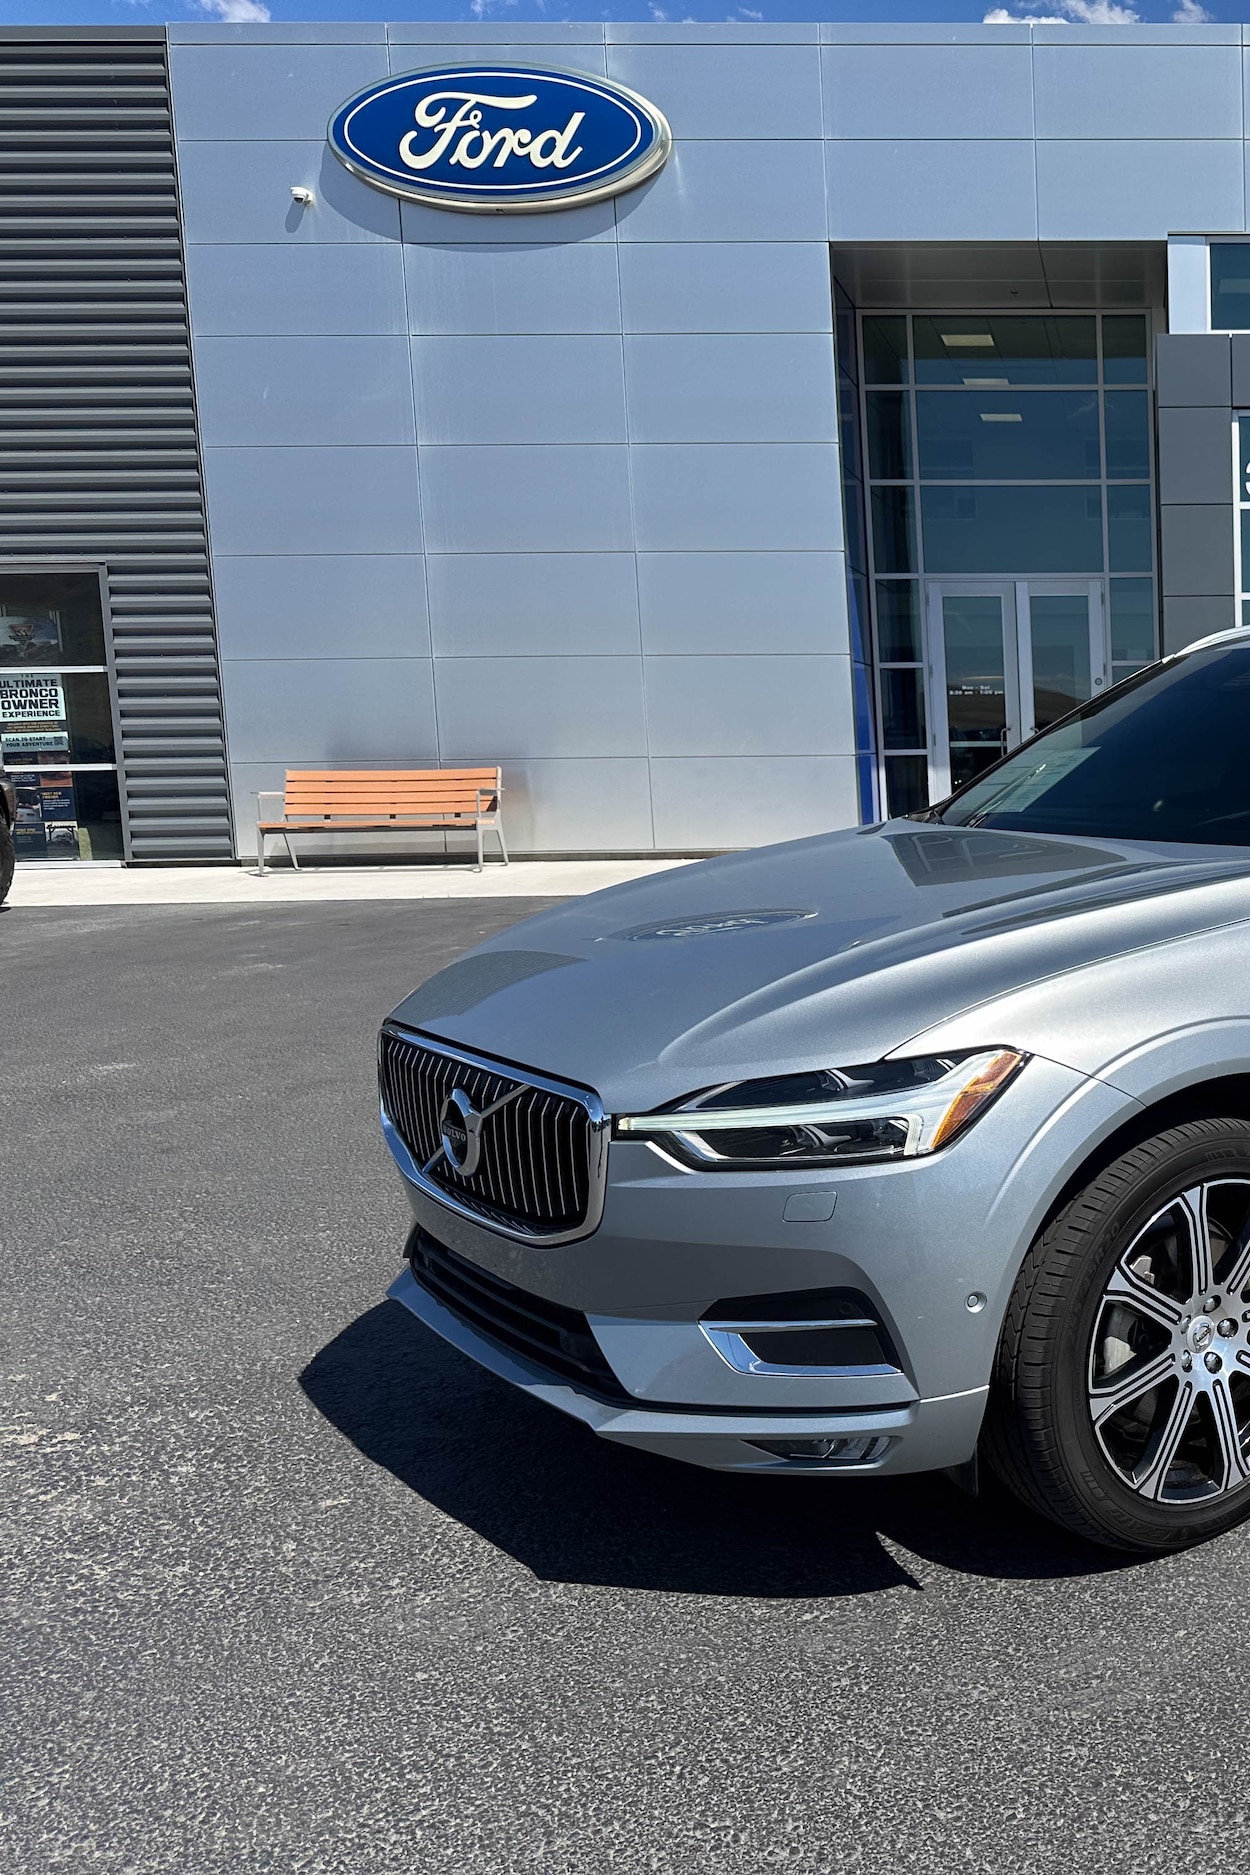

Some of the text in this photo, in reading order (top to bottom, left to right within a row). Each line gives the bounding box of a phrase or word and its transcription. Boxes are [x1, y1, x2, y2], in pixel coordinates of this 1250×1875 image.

[398, 91, 586, 170] Ford
[0, 679, 58, 688] ULTIMATE
[0, 688, 59, 699] BRONCO
[1, 699, 60, 710] OWNER
[2, 710, 61, 718] EXPERIENCE
[443, 1125, 467, 1142] VOLVO
